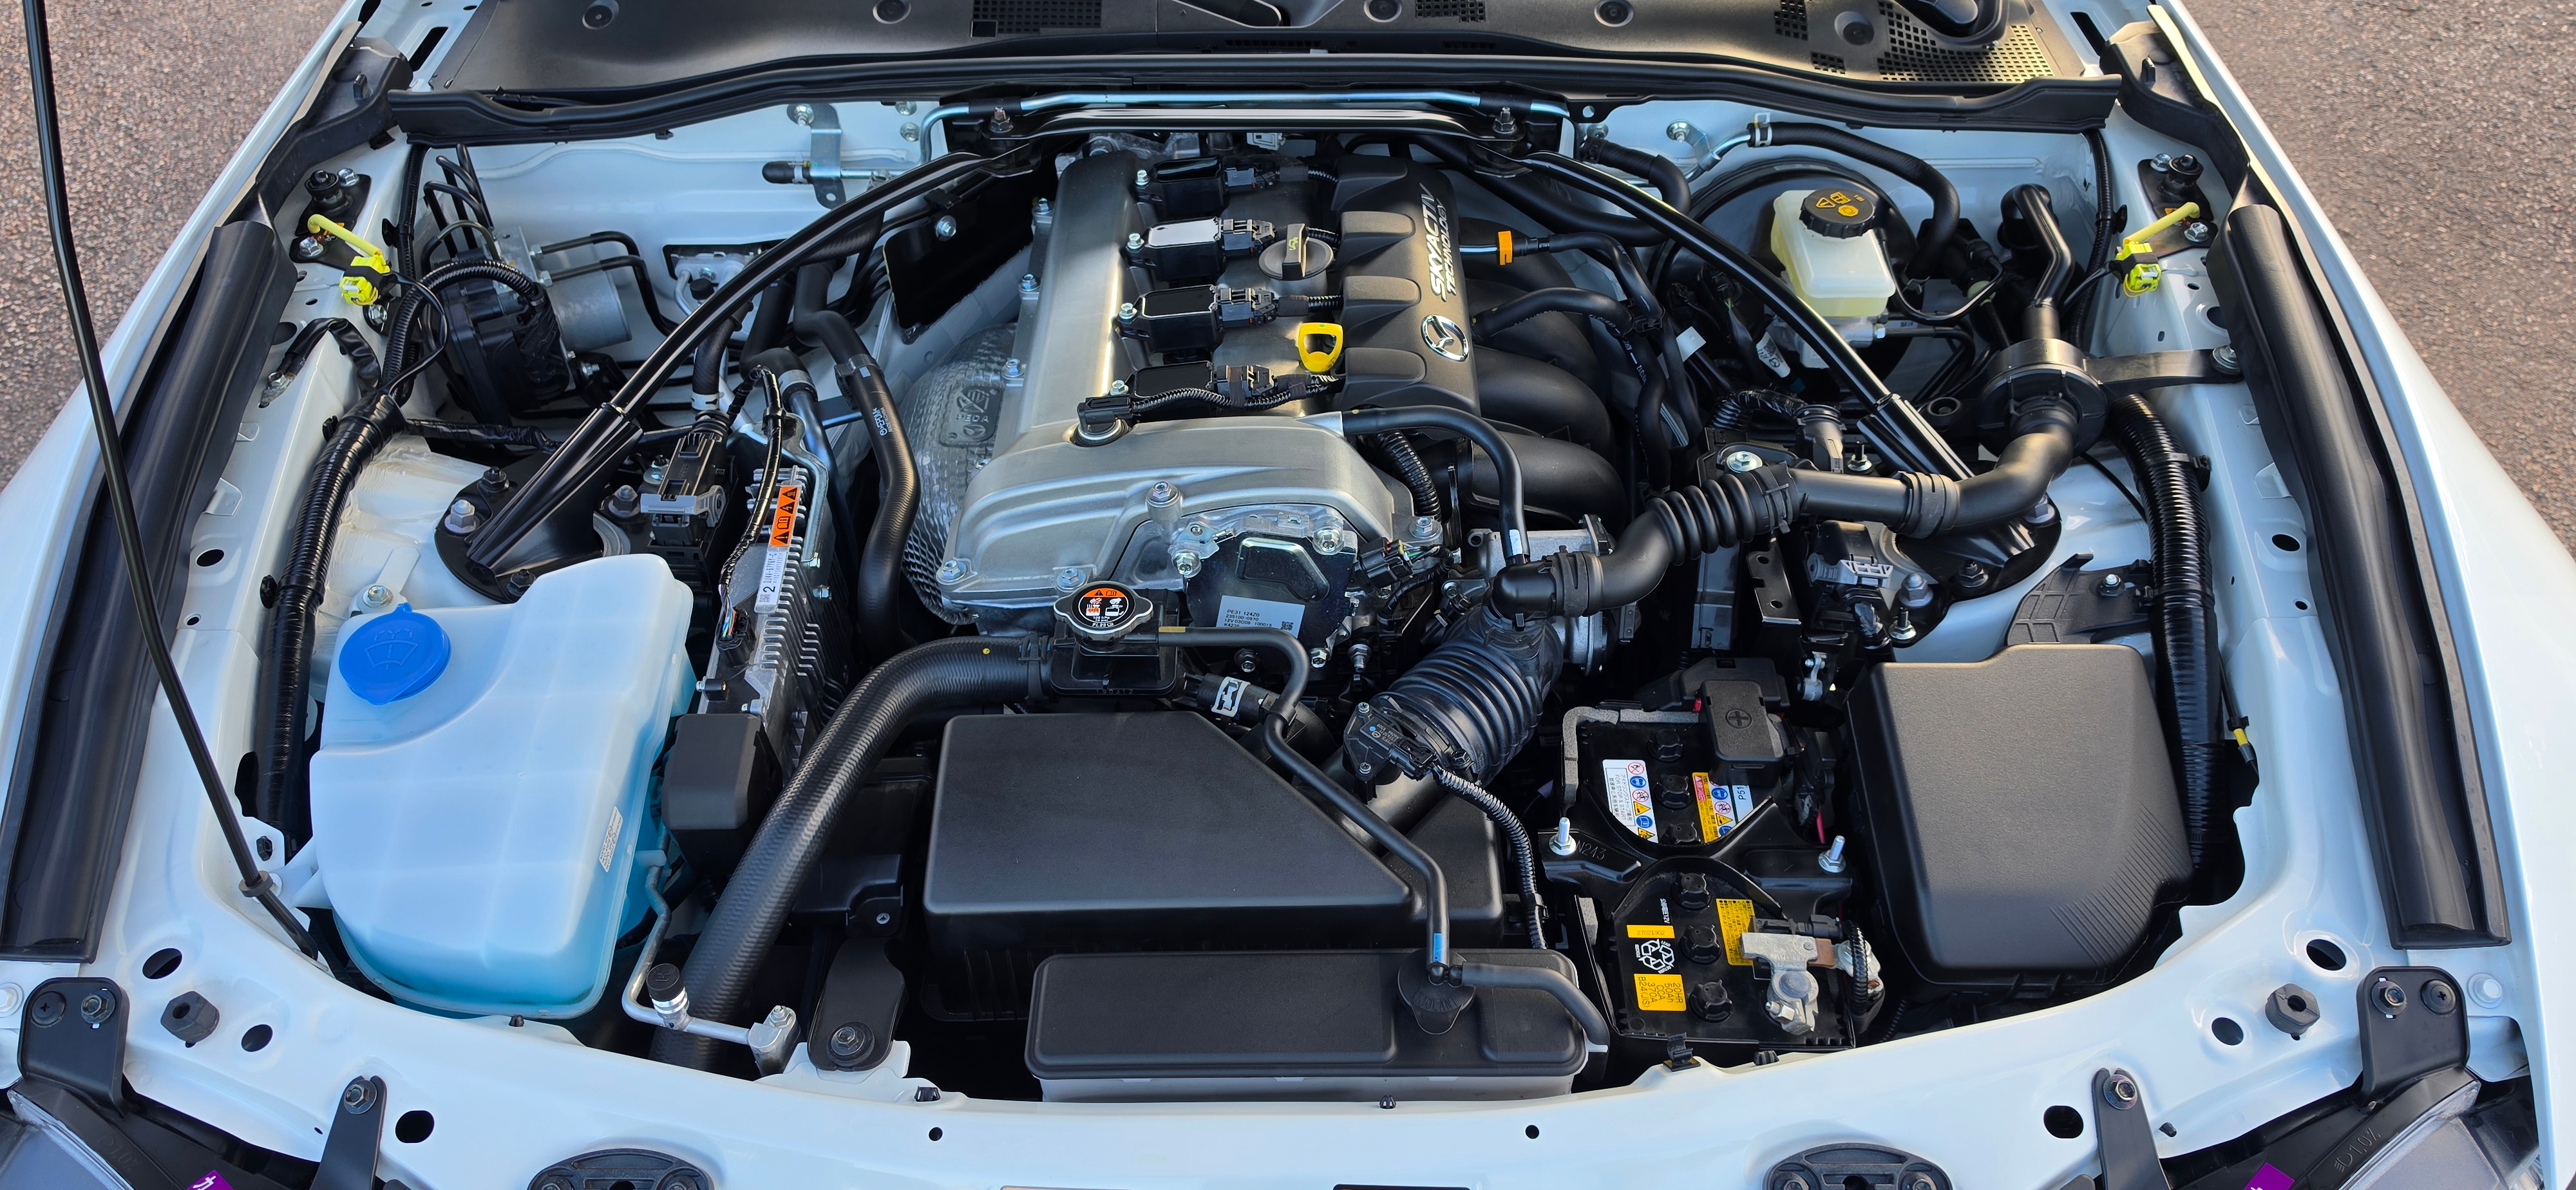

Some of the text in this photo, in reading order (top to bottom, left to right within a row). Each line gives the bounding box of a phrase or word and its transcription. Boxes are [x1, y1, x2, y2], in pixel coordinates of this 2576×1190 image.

[1419, 182, 1446, 303] SKYACTIV
[1435, 197, 1457, 296] TECHNOLOGY
[1737, 787, 1747, 800] P51
[1638, 977, 1650, 1008] B24(JIS)
[1648, 982, 1658, 1003] 370A
[1656, 985, 1665, 1001] CCA
[1665, 983, 1673, 1003] 50Ah
[1673, 983, 1683, 1003] 20HR
